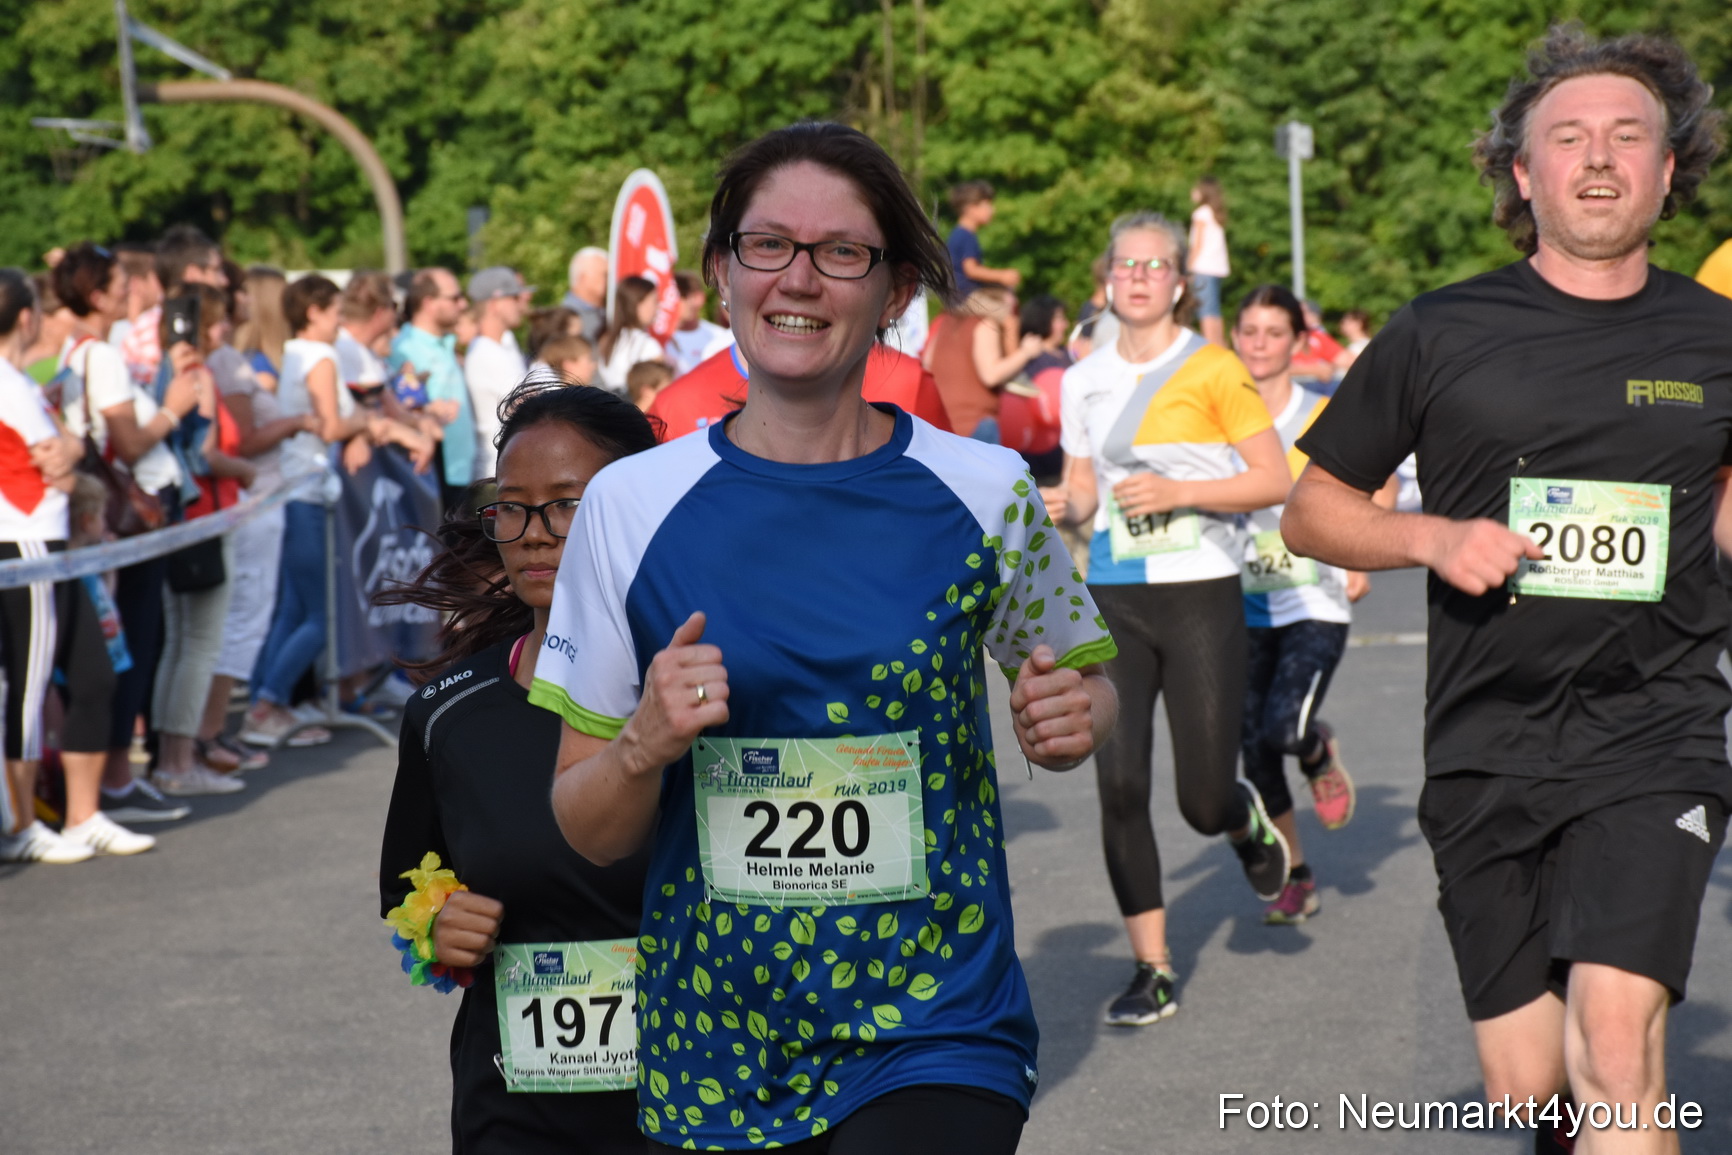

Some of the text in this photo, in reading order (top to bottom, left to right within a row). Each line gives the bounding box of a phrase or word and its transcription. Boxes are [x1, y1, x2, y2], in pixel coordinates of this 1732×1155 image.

[1655, 380, 1704, 403] ROSSBO
[1527, 522, 1646, 566] 2080
[1528, 563, 1645, 579] Roßberger Matthias
[1593, 579, 1619, 587] GmbH
[439, 669, 473, 691] JAKO
[727, 771, 814, 788] firmenlauf
[867, 778, 907, 795] 2019
[743, 799, 871, 859] 220
[746, 860, 875, 877] Helmle Melanie
[772, 879, 848, 890] Bionorica SE
[522, 969, 593, 986] firmenlauf
[521, 995, 637, 1048] 197
[549, 1051, 598, 1065] Kanael
[514, 1067, 545, 1079] Regens
[547, 1067, 581, 1079] Wagner
[583, 1065, 621, 1076] Stiftung
